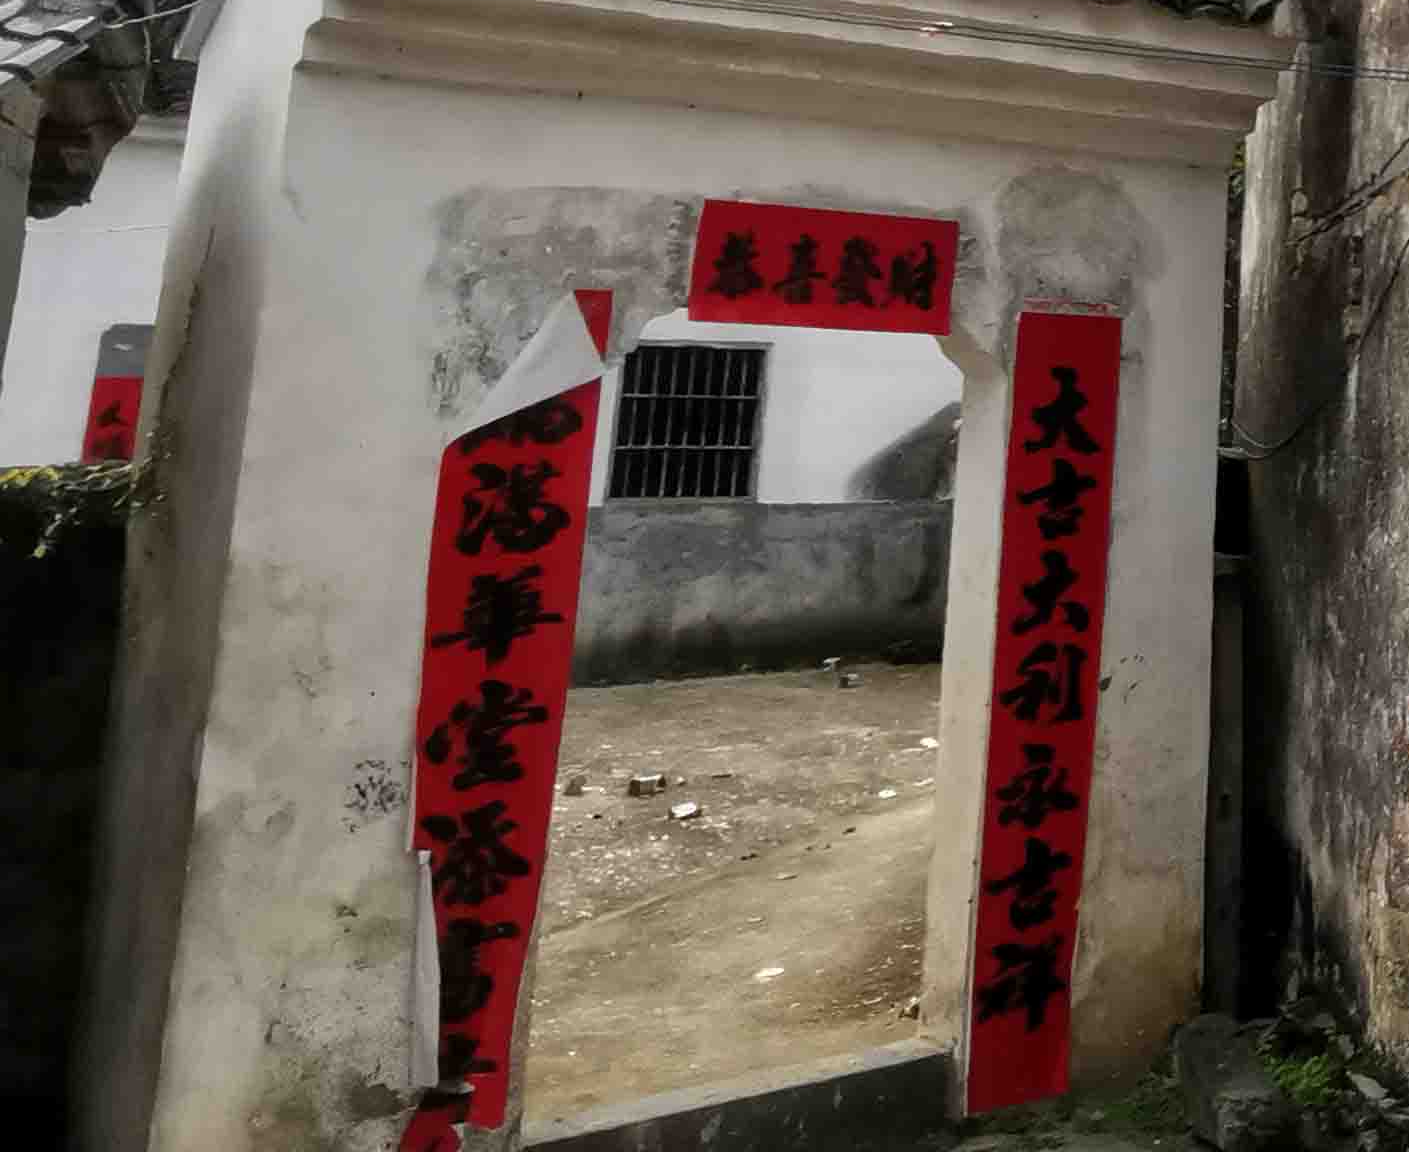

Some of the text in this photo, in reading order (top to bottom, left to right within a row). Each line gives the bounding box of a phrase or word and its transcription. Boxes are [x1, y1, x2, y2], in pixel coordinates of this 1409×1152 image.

[976, 366, 1102, 1034] 大吉大利永吉祥
